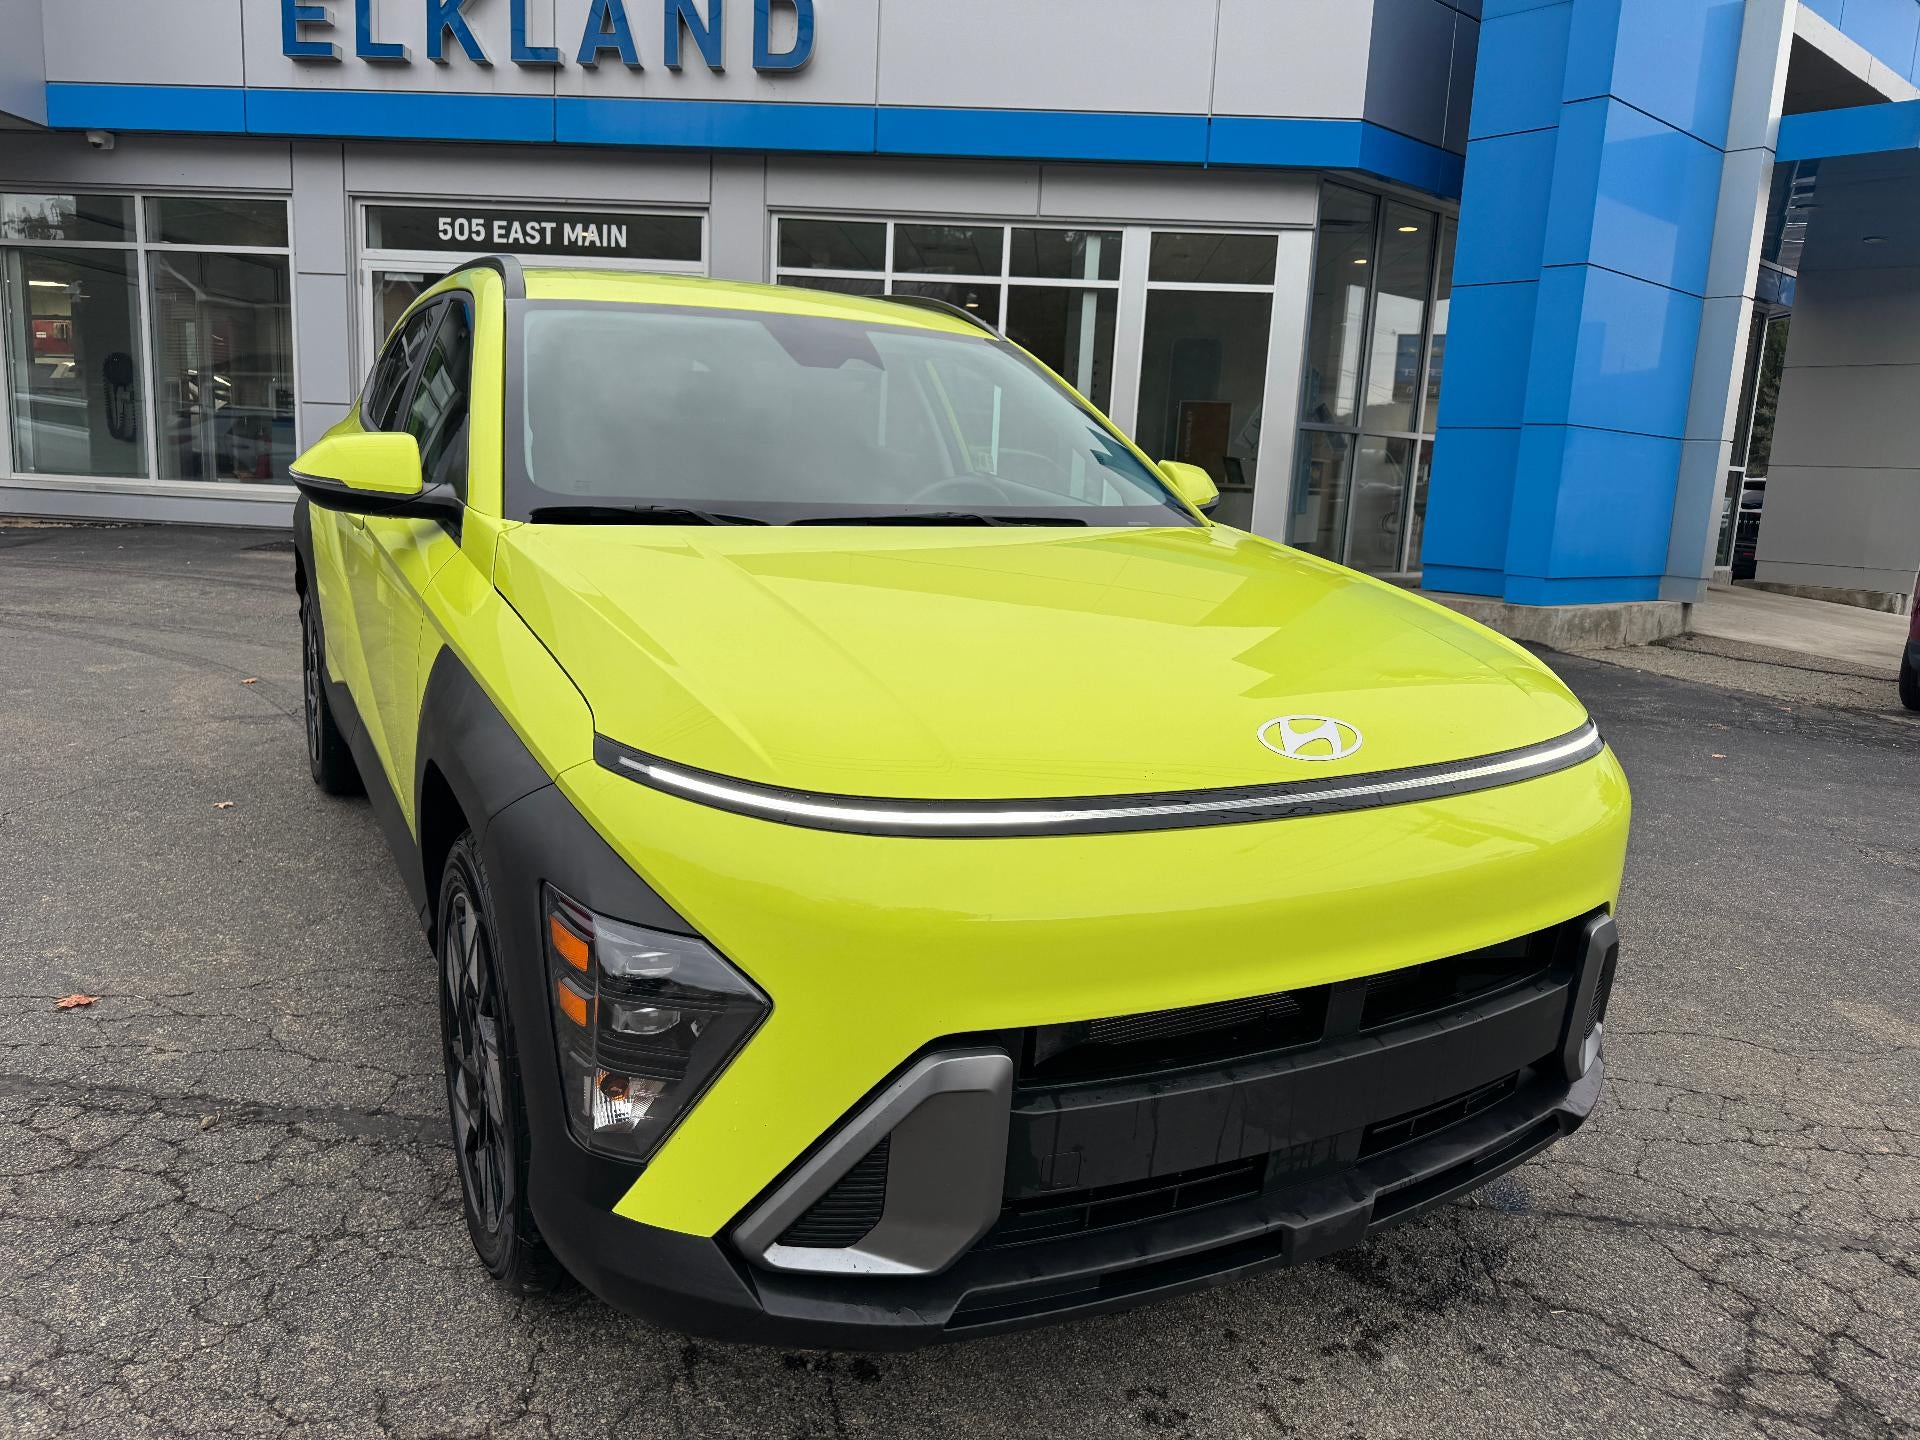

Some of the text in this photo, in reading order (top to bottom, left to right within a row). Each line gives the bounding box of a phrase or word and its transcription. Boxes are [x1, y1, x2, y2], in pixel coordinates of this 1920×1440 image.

[281, 0, 815, 71] ELKLAND
[438, 217, 627, 248] 505 EAST MAIN
